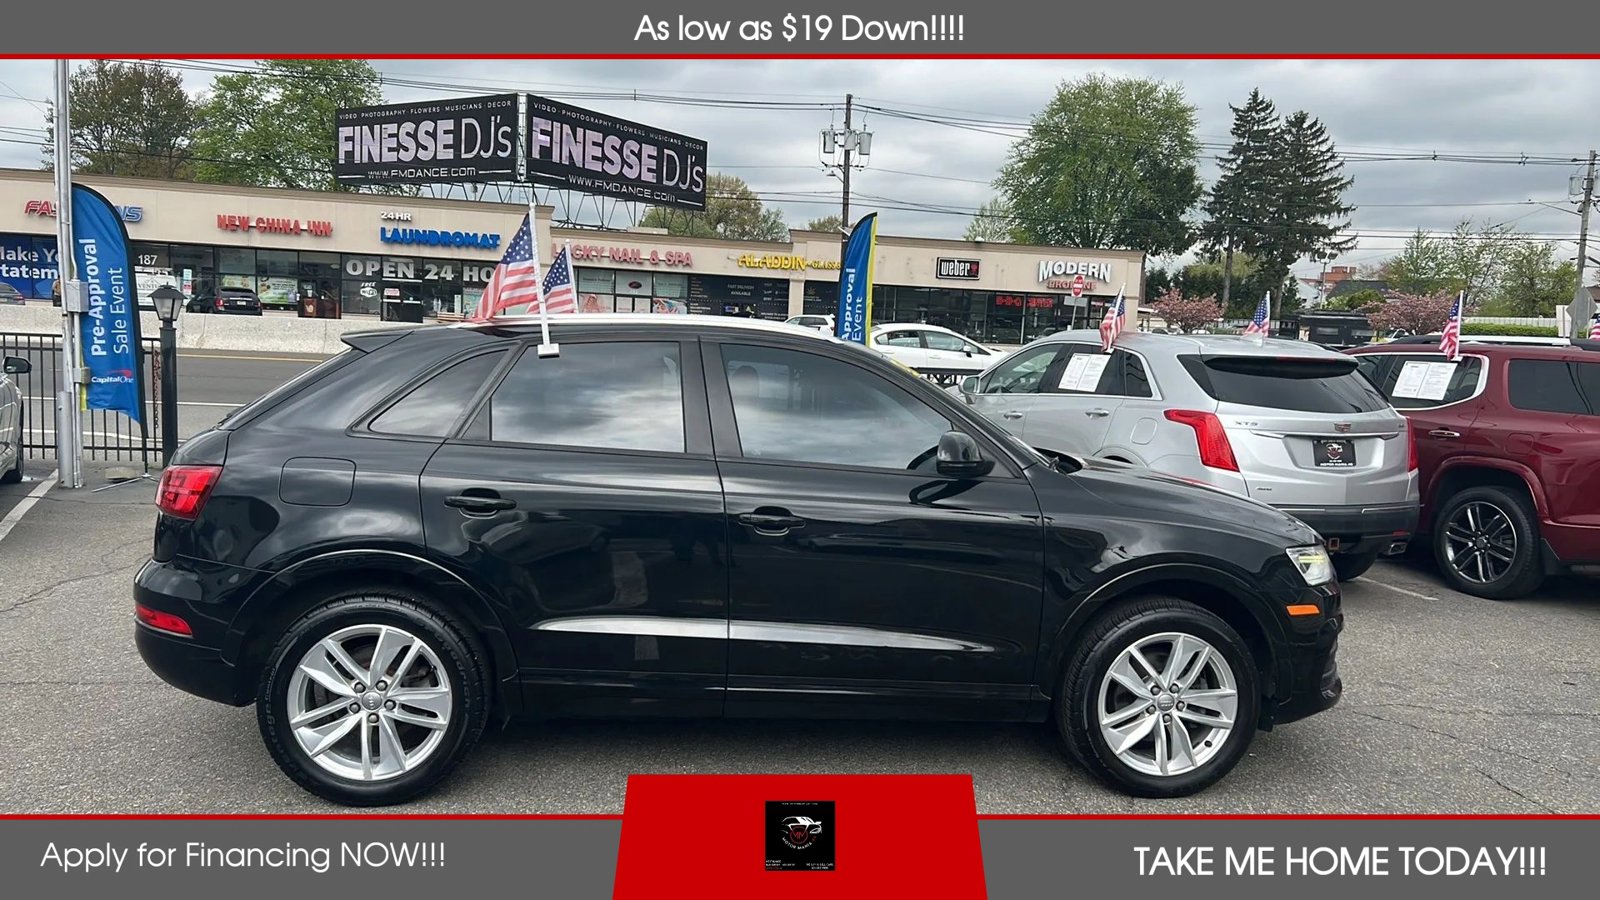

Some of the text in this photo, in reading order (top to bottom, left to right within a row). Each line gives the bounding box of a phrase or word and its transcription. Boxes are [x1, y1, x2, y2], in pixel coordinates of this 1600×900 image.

[361, 109, 406, 118] PHOTOGRAPHY
[410, 106, 440, 114] FLOWERS
[445, 103, 482, 111] MUSICIANS
[487, 100, 512, 108] DECOR
[533, 102, 557, 114] VIDEO
[562, 109, 612, 128] PHOTOGRAPHY
[616, 124, 646, 137] FLOWERS
[338, 119, 454, 164] FINESSE
[532, 116, 658, 184] FINESSE
[217, 214, 333, 238] NEW CHINA INN
[381, 211, 412, 221] 24 HR
[380, 226, 501, 249] LAUNDROMAT
[138, 254, 158, 266] 187
[552, 243, 693, 267] LCKY NAIL & SPA
[737, 251, 806, 271] ALADDIN
[346, 260, 414, 279] OPEN
[424, 264, 454, 281] 24
[941, 260, 970, 277] weber
[1039, 261, 1112, 283] MODERN
[79, 239, 107, 355] Pre-Approval
[108, 267, 129, 354] Sale Event
[851, 296, 863, 341] Event
